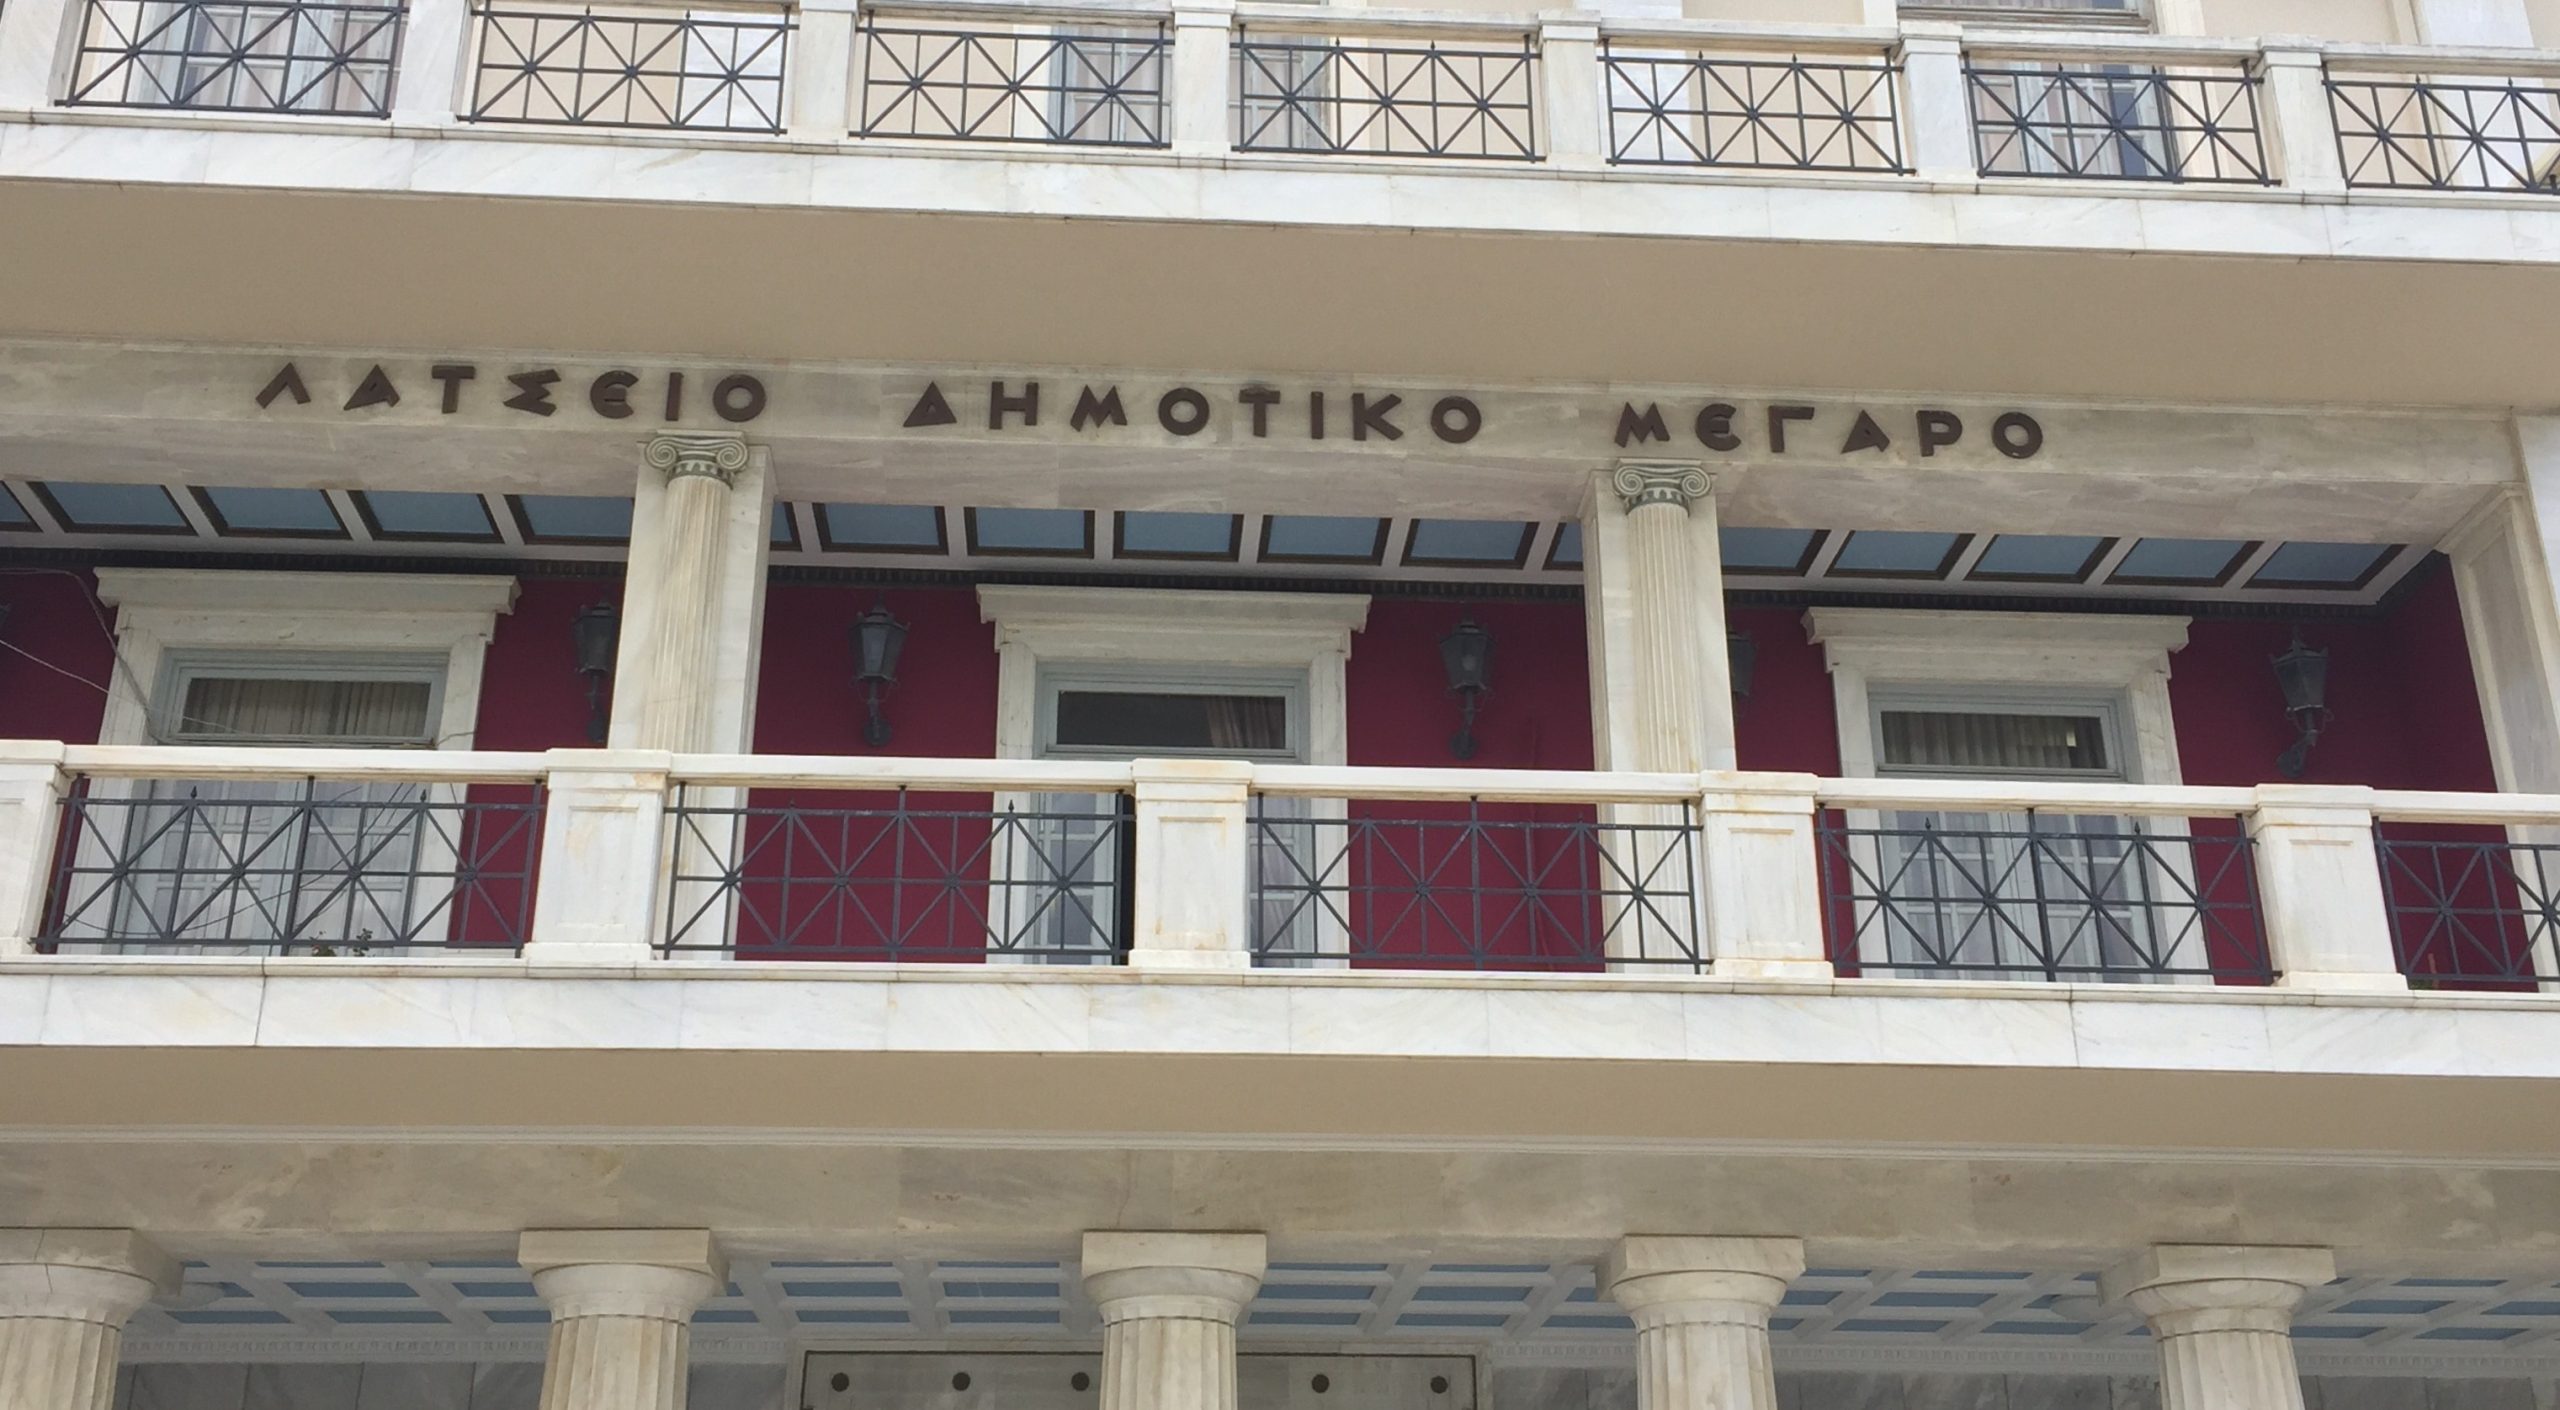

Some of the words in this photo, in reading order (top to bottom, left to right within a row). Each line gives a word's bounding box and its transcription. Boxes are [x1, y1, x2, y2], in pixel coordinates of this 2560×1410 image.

[255, 362, 766, 422] ΛΑΤΣΕΙΟ
[903, 381, 1482, 444] ΔΗΜΟΤΙΚΟ
[1614, 402, 2043, 459] ΜΕΓΑΡΟ
